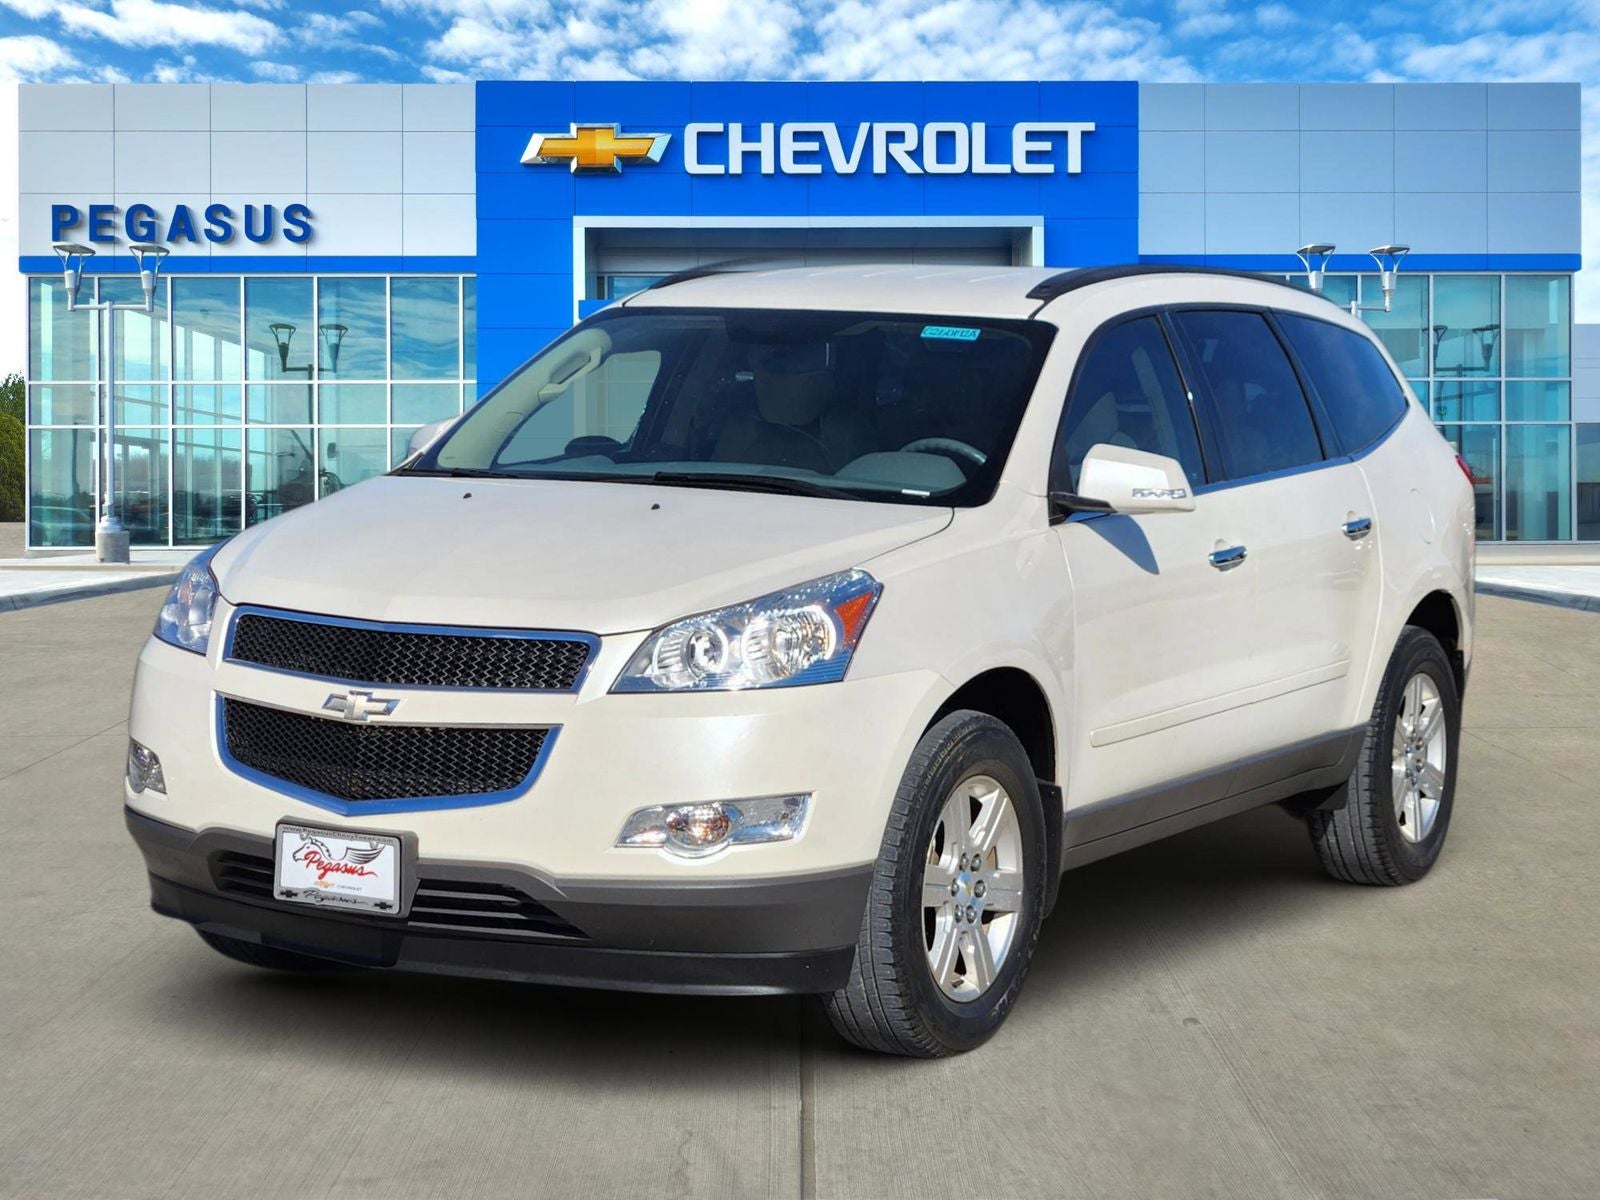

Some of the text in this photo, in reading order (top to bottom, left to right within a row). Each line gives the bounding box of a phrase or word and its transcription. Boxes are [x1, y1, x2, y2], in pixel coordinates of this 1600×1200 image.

[683, 121, 1096, 175] CHEVROLET
[51, 203, 313, 243] PEGASUS
[303, 850, 378, 880] Pegasus
[303, 888, 370, 906] Pegasus
